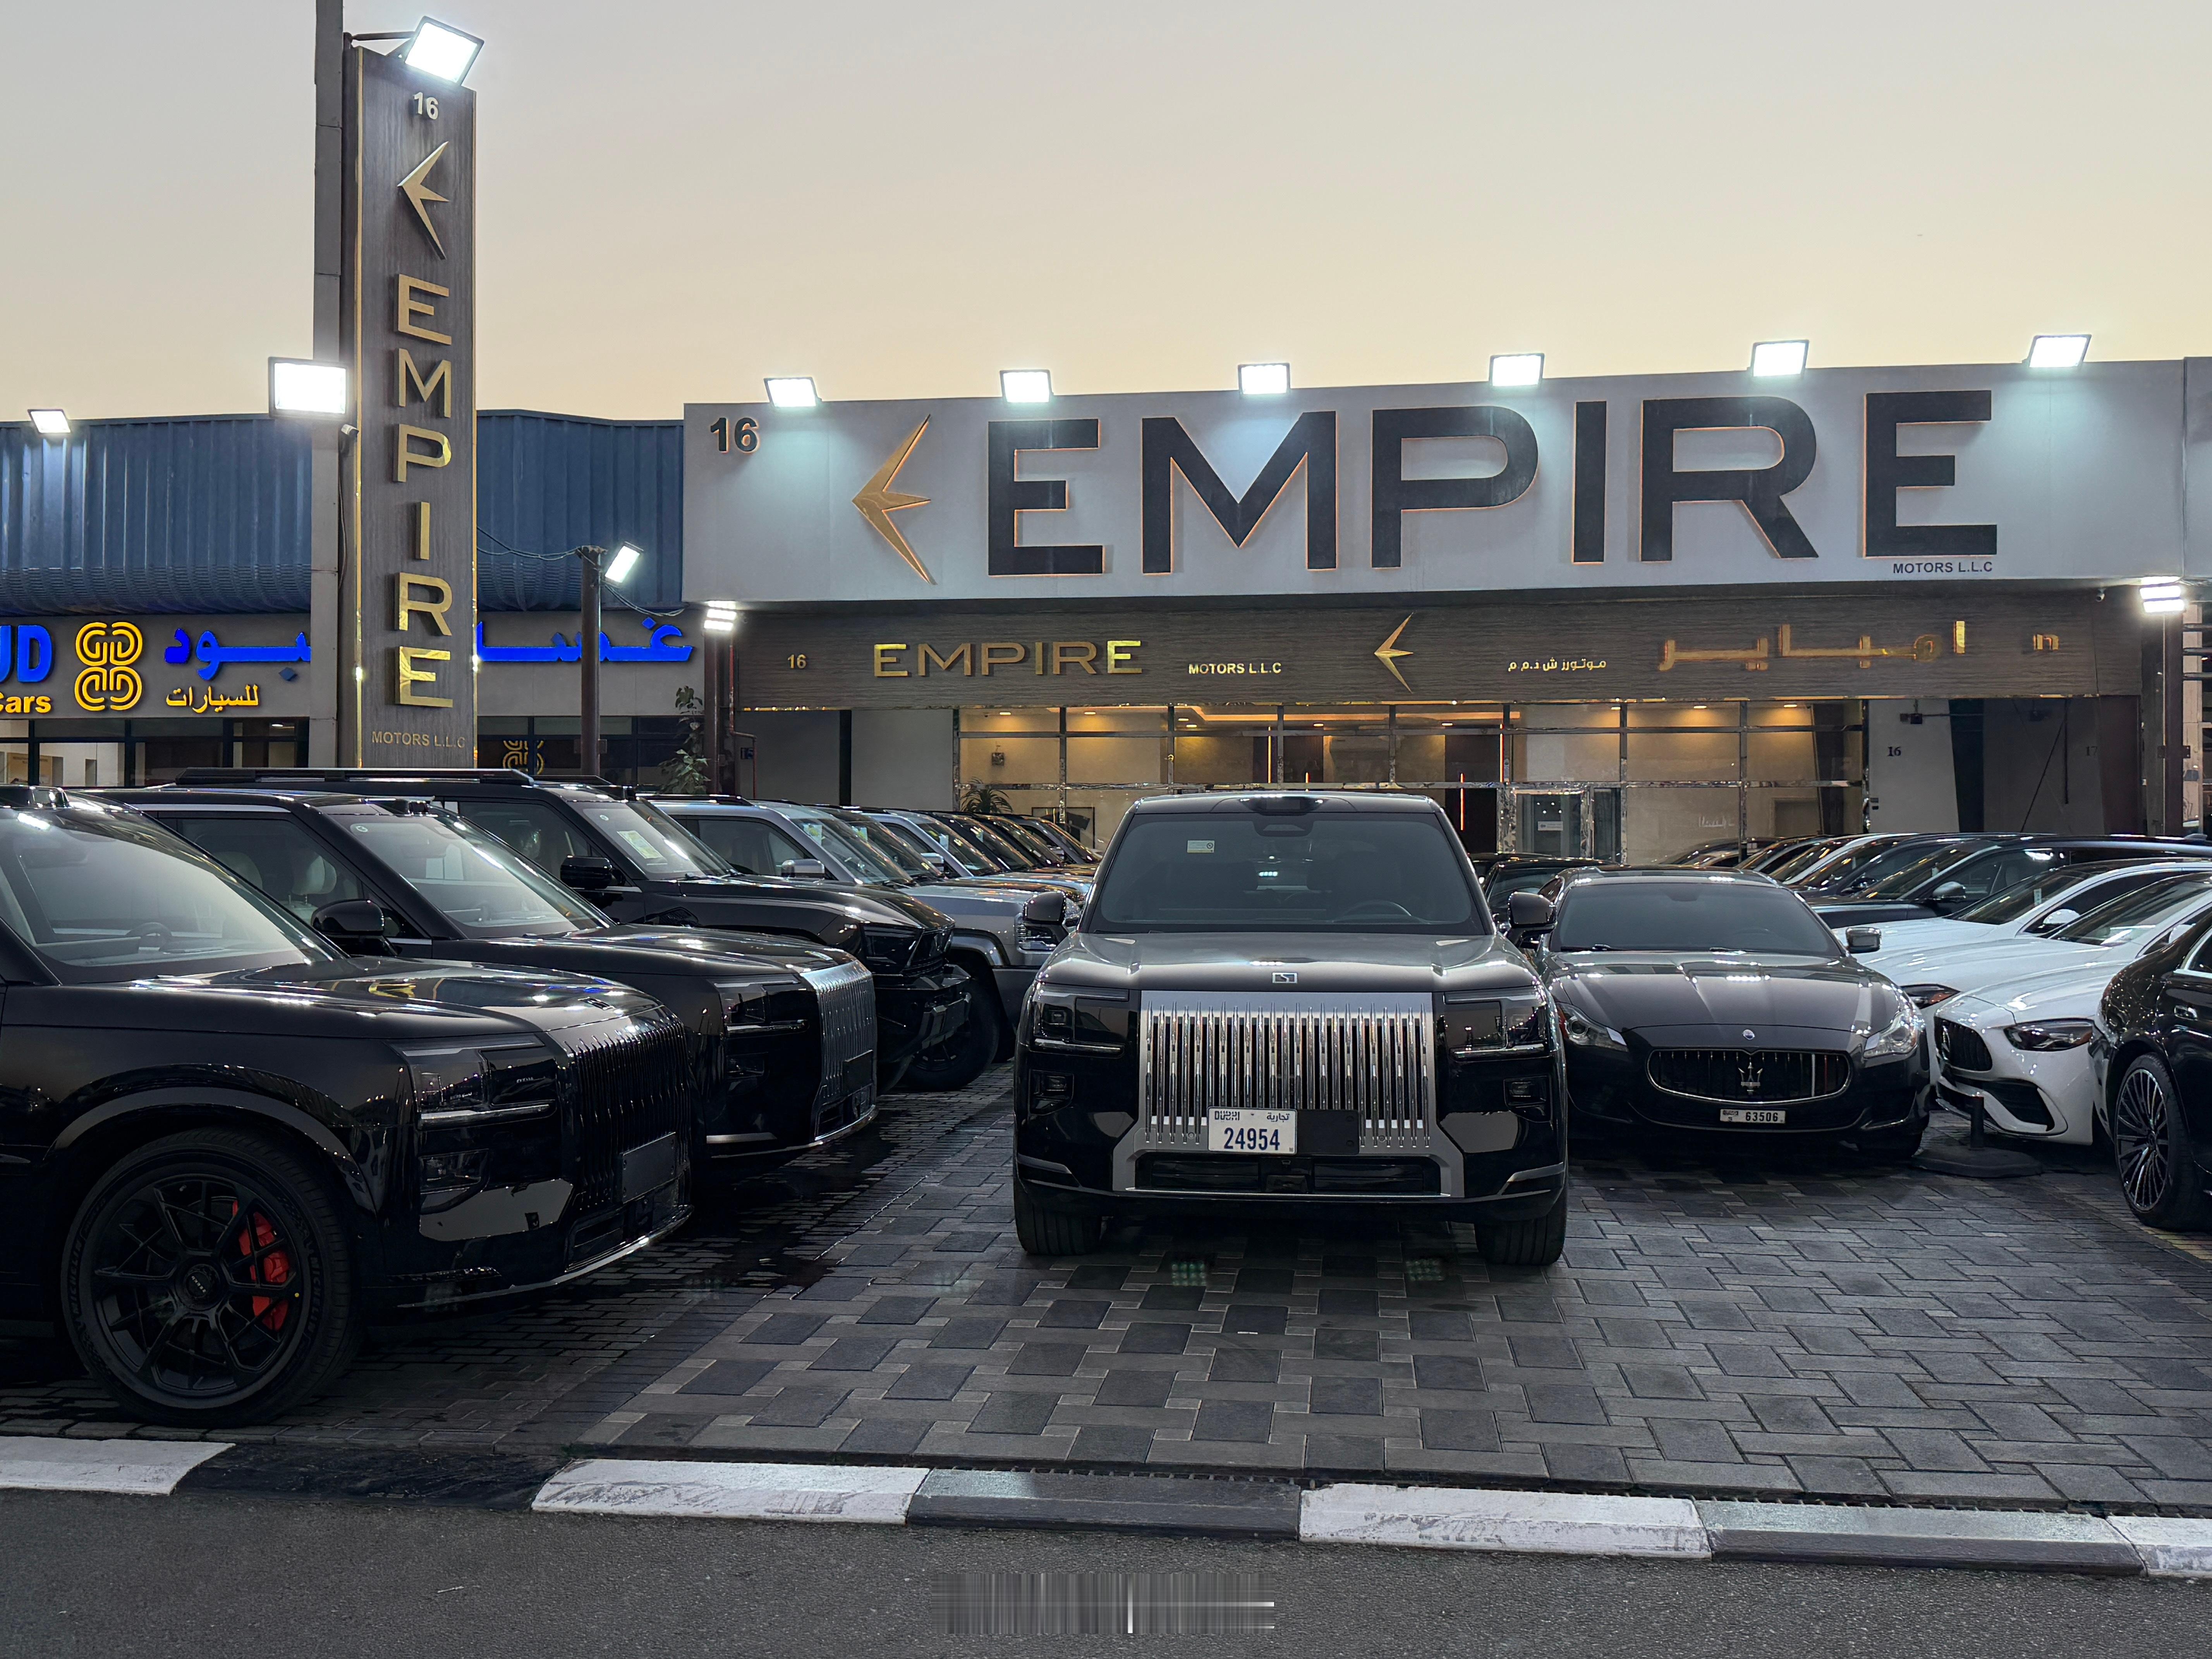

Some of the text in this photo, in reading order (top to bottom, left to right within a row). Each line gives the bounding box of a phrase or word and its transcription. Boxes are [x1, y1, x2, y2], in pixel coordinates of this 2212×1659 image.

[413, 92, 438, 120] 16
[710, 417, 758, 452] 16
[396, 274, 453, 708] EMPIRE
[988, 390, 1997, 576] EMPIRE
[1893, 562, 1992, 574] MOTORS L.L.C
[164, 628, 311, 681] بود
[787, 654, 806, 668] 16
[874, 640, 1142, 677] EMPIRE
[1561, 659, 1606, 671] موتورز
[1188, 663, 1281, 674] MOTORS L.L.C
[0, 692, 51, 713] ars
[166, 684, 258, 713] للسيارات
[372, 731, 465, 748] MOTORS L.L.C
[1887, 746, 1901, 756] 16
[2086, 746, 2098, 756] 17
[1267, 1112, 1290, 1122] تجارية
[1746, 1112, 1778, 1121] 63506
[1224, 1127, 1280, 1151] 24954
[69, 1239, 82, 1314] MICHELIN
[308, 1257, 321, 1333] MICHELIN
